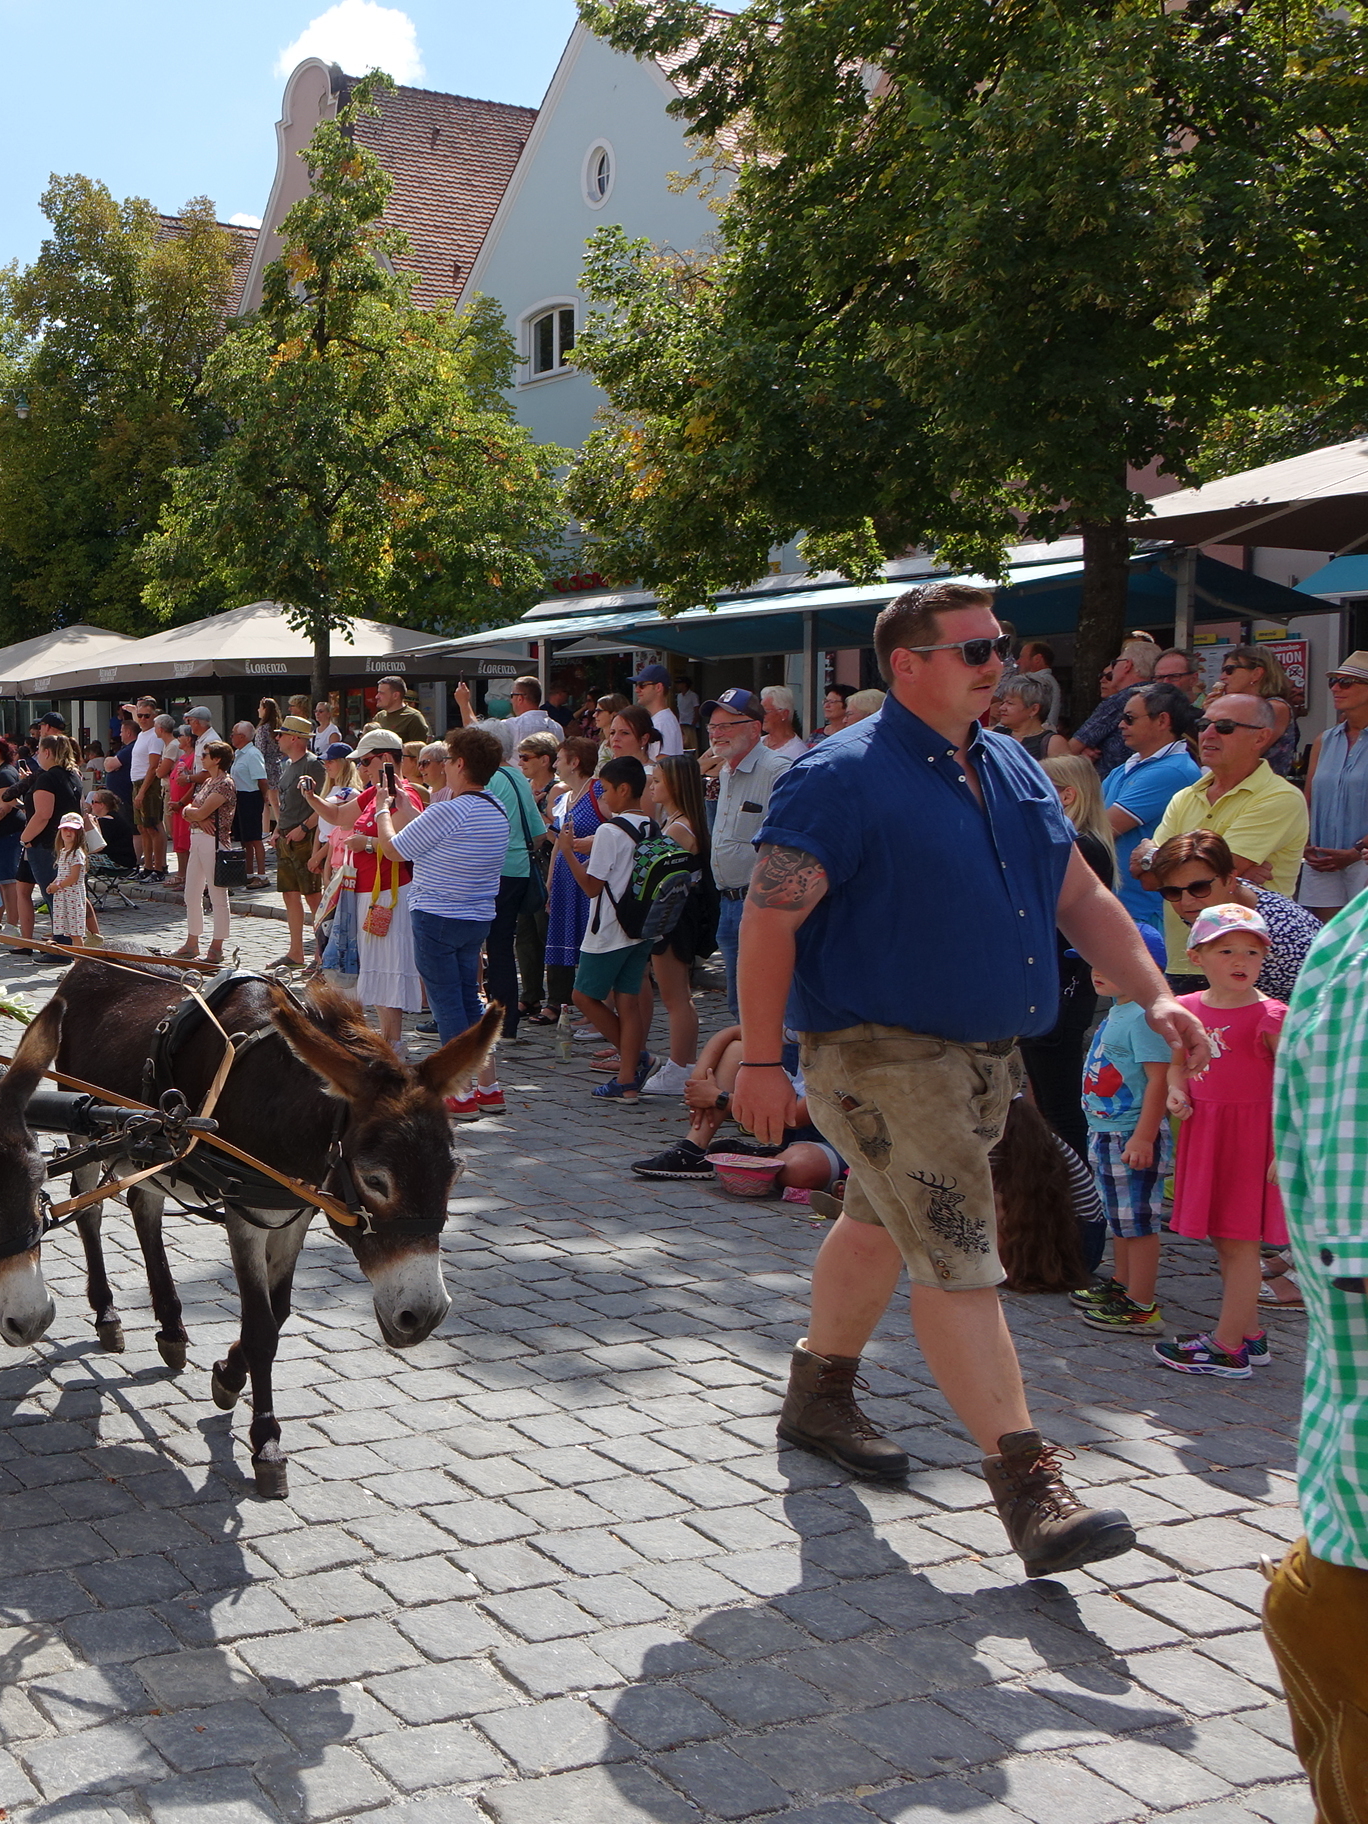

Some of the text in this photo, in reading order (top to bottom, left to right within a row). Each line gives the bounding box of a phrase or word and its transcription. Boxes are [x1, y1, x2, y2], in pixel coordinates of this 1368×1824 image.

[250, 663, 288, 674] LORENZO
[371, 661, 407, 672] LORENZO
[483, 664, 517, 675] LORENZO
